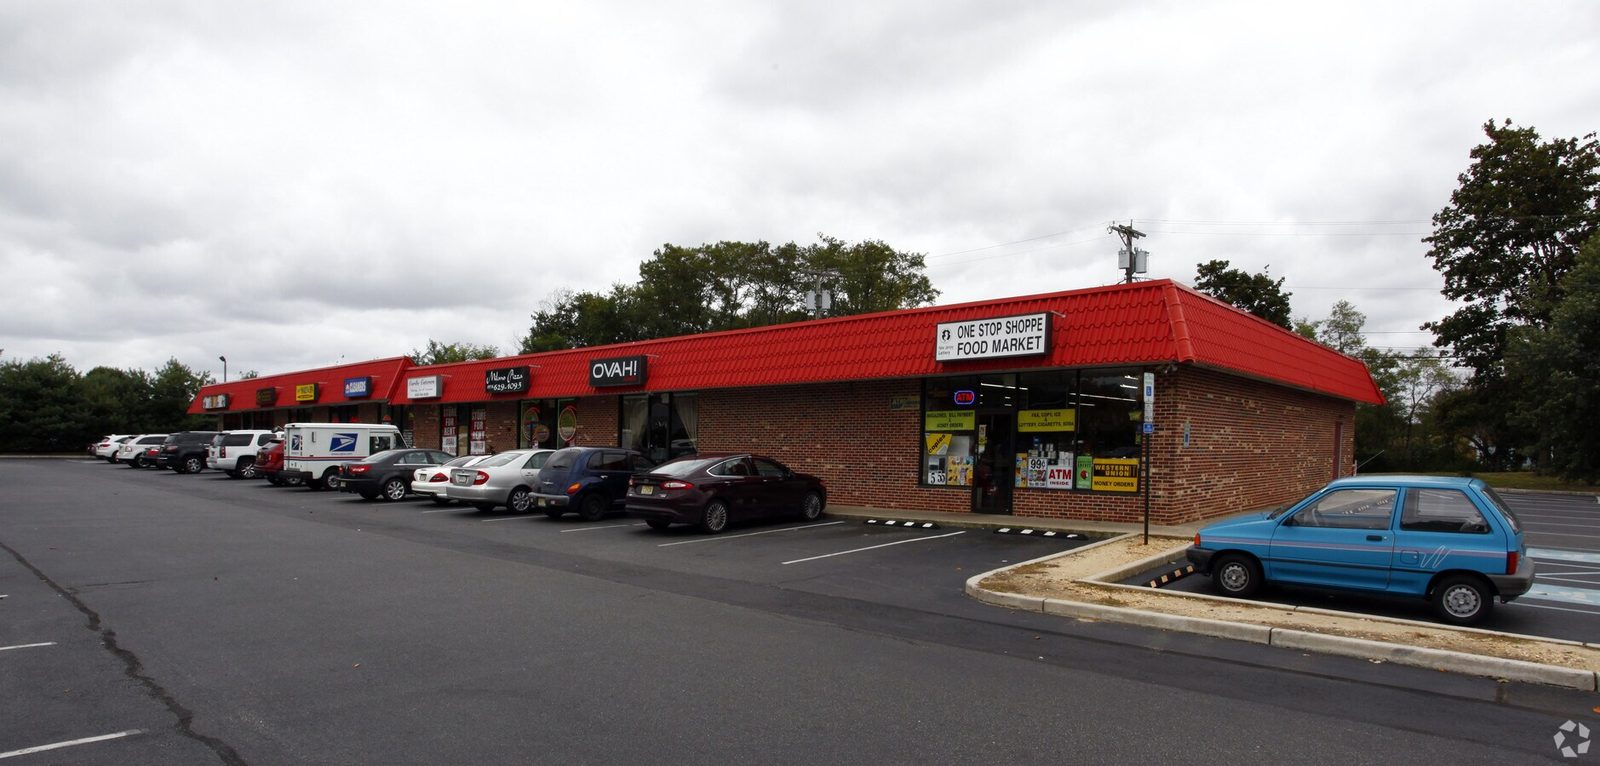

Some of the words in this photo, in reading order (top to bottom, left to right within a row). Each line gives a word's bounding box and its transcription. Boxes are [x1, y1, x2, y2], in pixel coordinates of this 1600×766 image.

[957, 324, 976, 339] ONE
[978, 321, 1002, 337] STOP
[1005, 317, 1043, 335] SHOPPE
[957, 340, 988, 356] FOOD
[992, 335, 1042, 353] MARKET
[592, 360, 638, 378] OVAH!
[957, 393, 972, 401] ATM
[471, 411, 486, 420] STORE
[445, 417, 454, 426] FOR
[473, 421, 484, 430] FOR
[444, 427, 456, 436] RENT
[472, 431, 485, 440] RENT
[928, 434, 946, 453] copies
[1048, 469, 1072, 480] ATM
